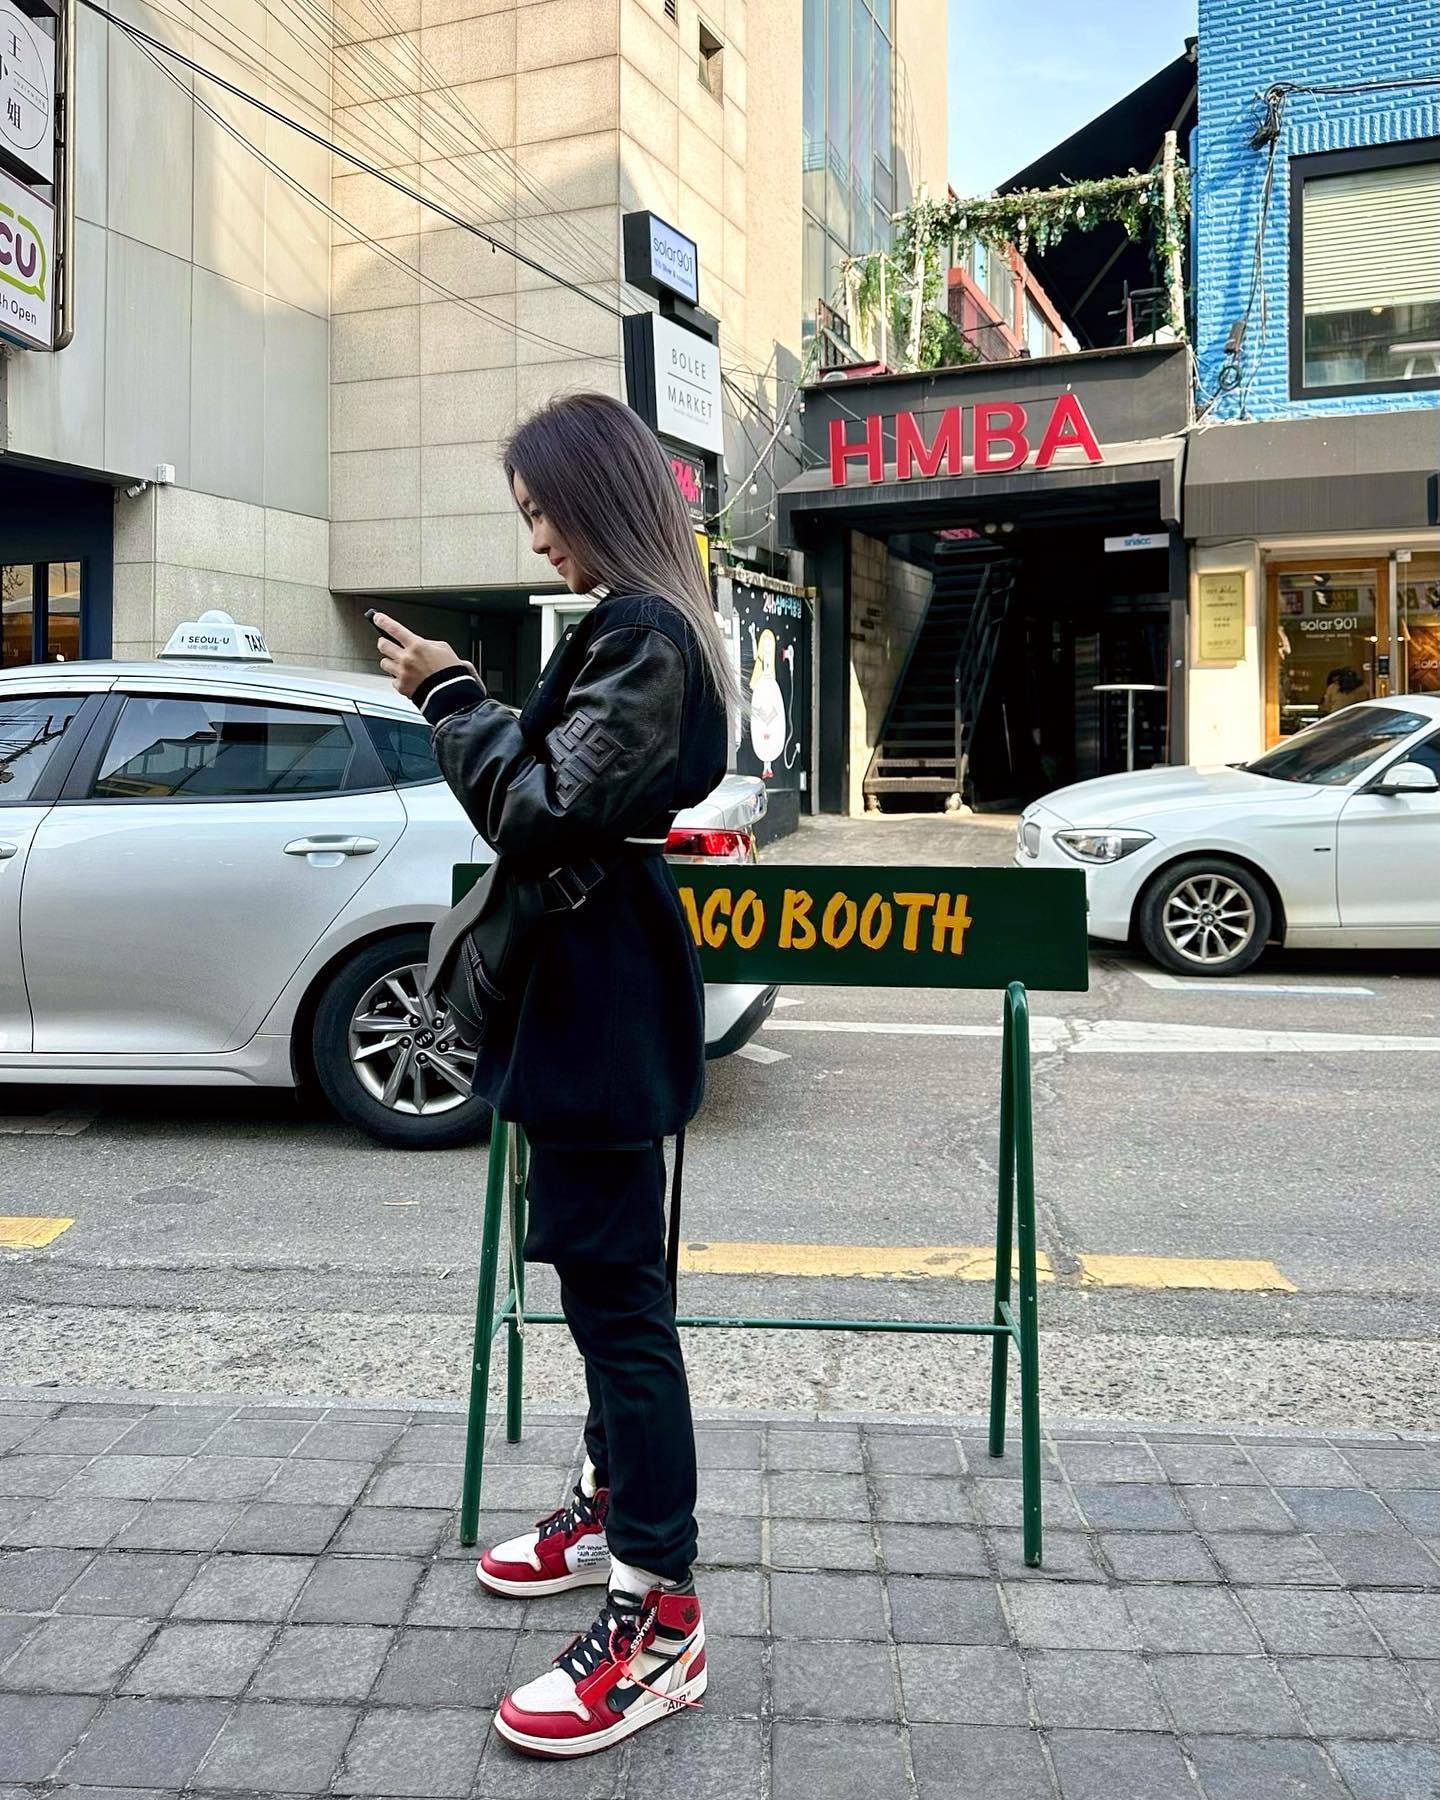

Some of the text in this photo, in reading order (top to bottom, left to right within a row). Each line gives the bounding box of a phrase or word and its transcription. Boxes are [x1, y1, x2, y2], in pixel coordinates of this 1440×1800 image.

[653, 237, 693, 275] solar901
[11, 300, 37, 325] Open
[671, 348, 706, 380] BOLEE
[667, 385, 712, 418] MARKET
[829, 393, 1104, 487] HMBA
[1300, 617, 1358, 632] solar901
[778, 888, 972, 955] BOOTH
